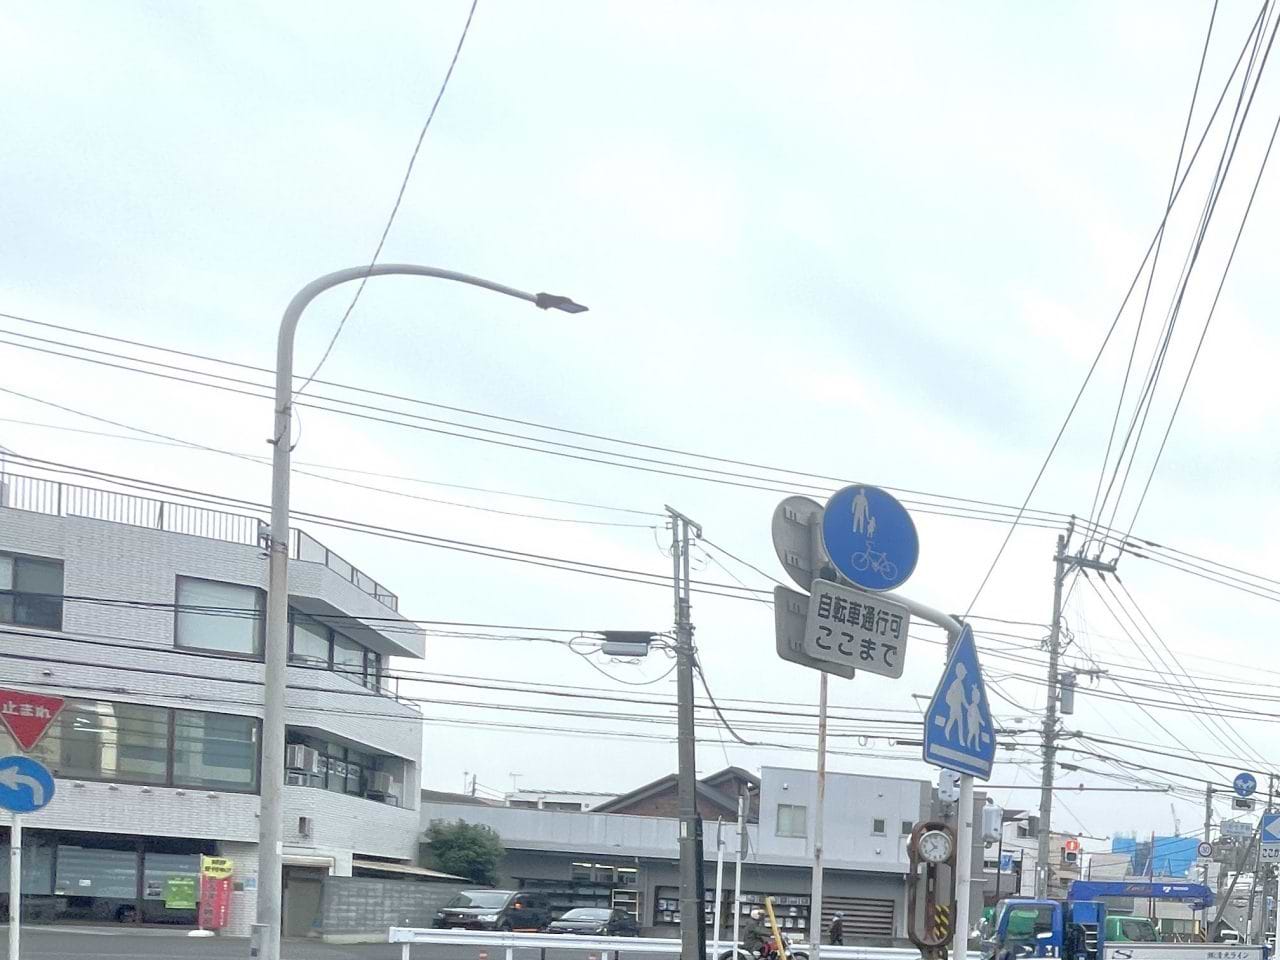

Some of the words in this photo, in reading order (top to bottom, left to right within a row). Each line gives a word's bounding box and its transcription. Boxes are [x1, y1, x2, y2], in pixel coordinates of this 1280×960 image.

[817, 592, 903, 639] 自転車通行可
[815, 625, 898, 667] ここまで
[2, 700, 52, 718] 止まれ
